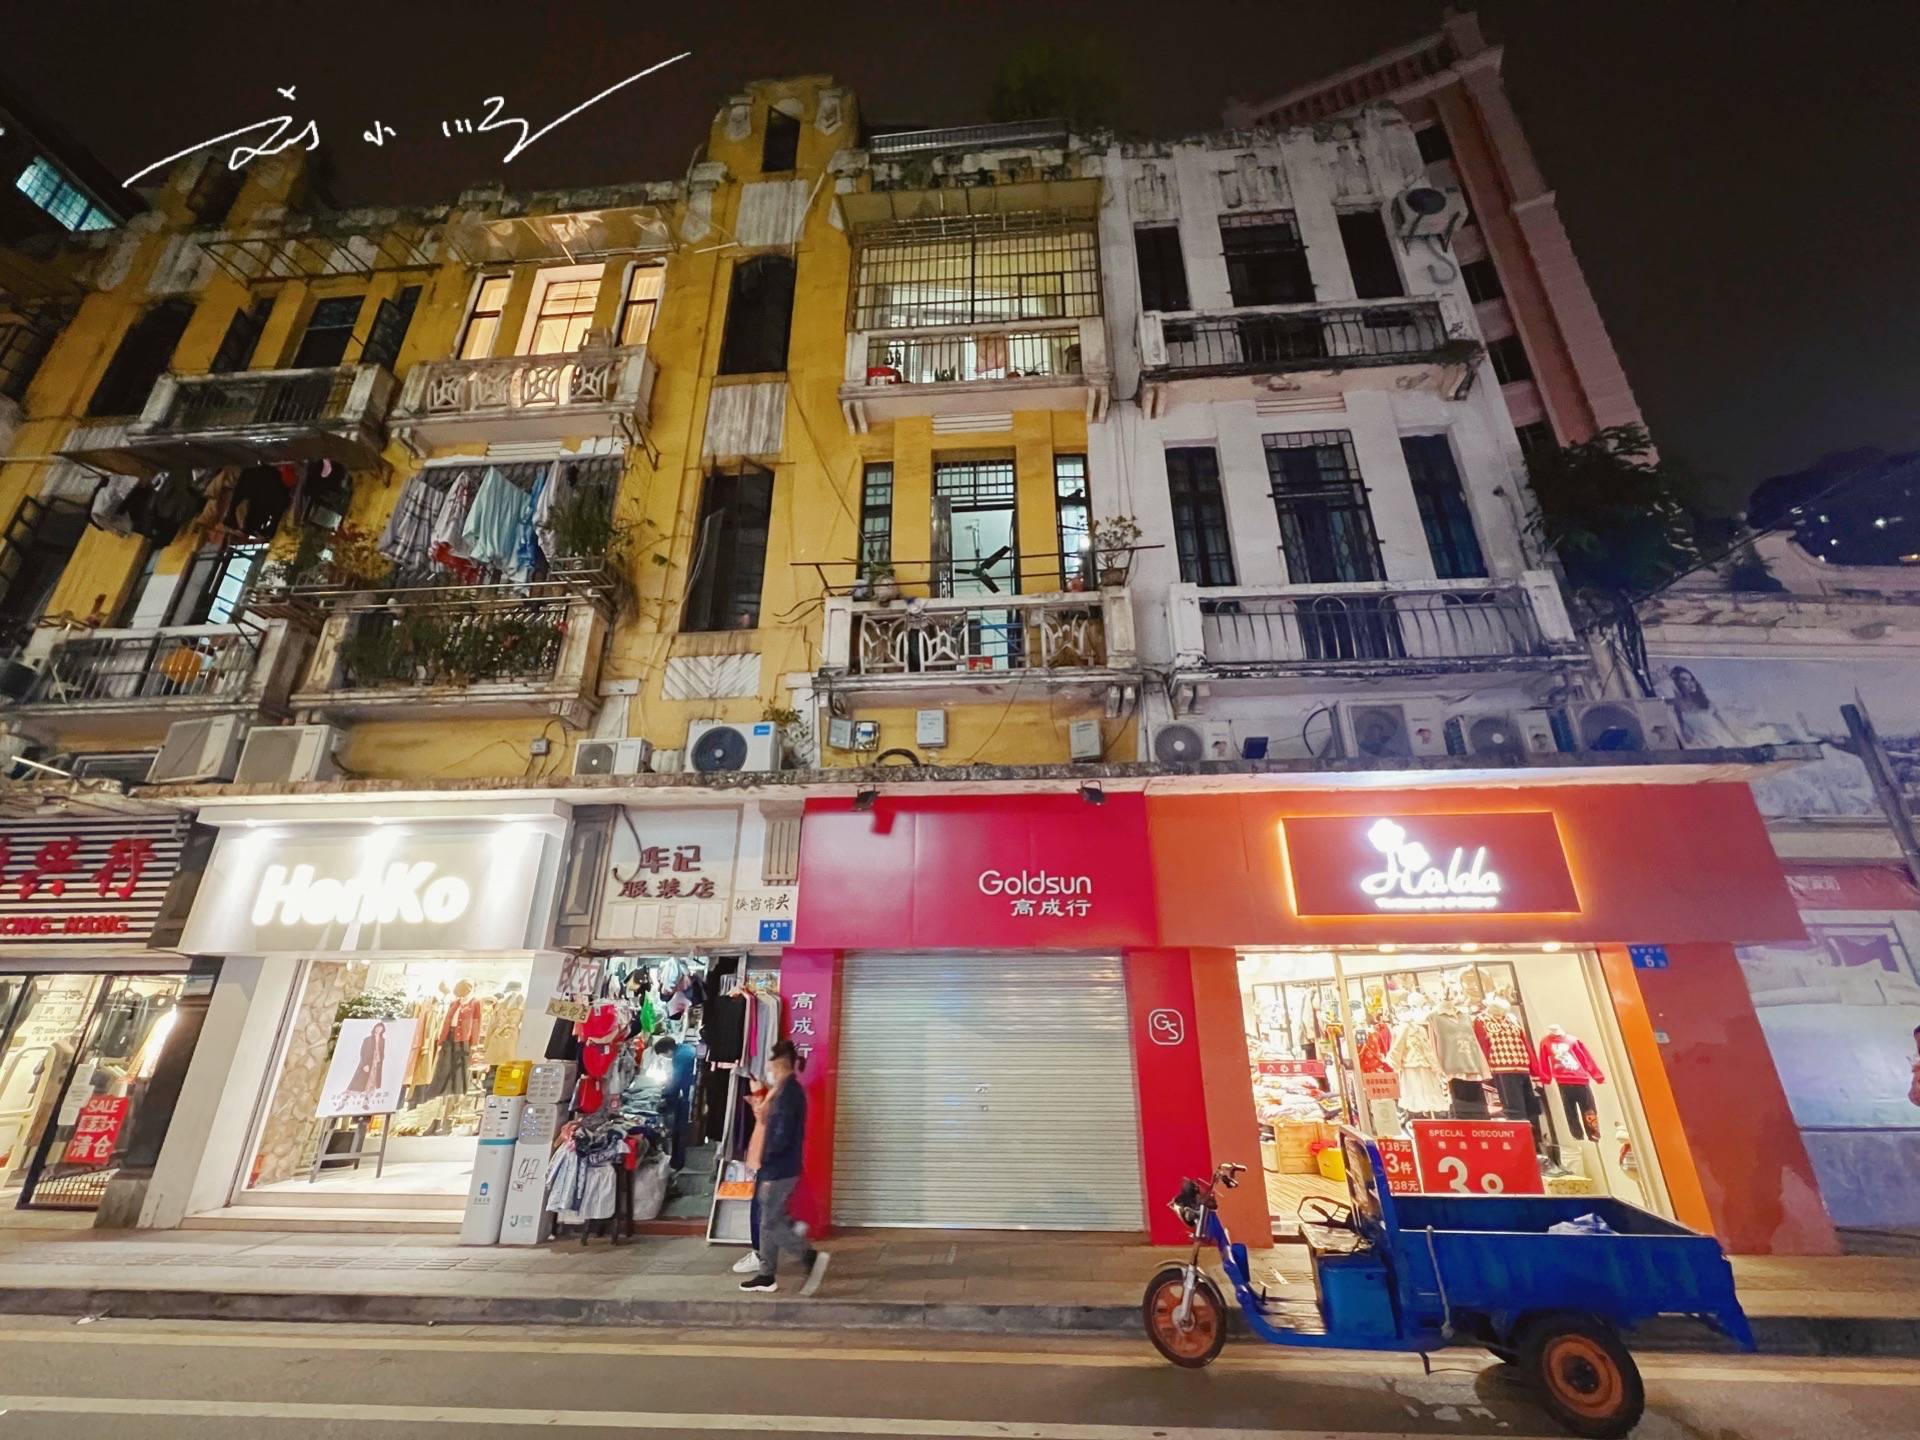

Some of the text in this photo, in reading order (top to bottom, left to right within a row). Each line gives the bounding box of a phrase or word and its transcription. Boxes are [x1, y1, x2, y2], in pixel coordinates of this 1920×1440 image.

[617, 877, 716, 899] 服装店
[978, 869, 1092, 895] Goldsun
[1010, 898, 1092, 917] 高成行
[770, 928, 779, 941] 8
[1644, 955, 1655, 967] 6
[789, 991, 817, 1060] 高成行
[87, 1099, 121, 1113] SALE
[1471, 1130, 1515, 1138] DISCOUNT
[70, 1134, 112, 1158] 清仓
[1379, 1141, 1412, 1152] 138元
[1385, 1153, 1413, 1174] 3件
